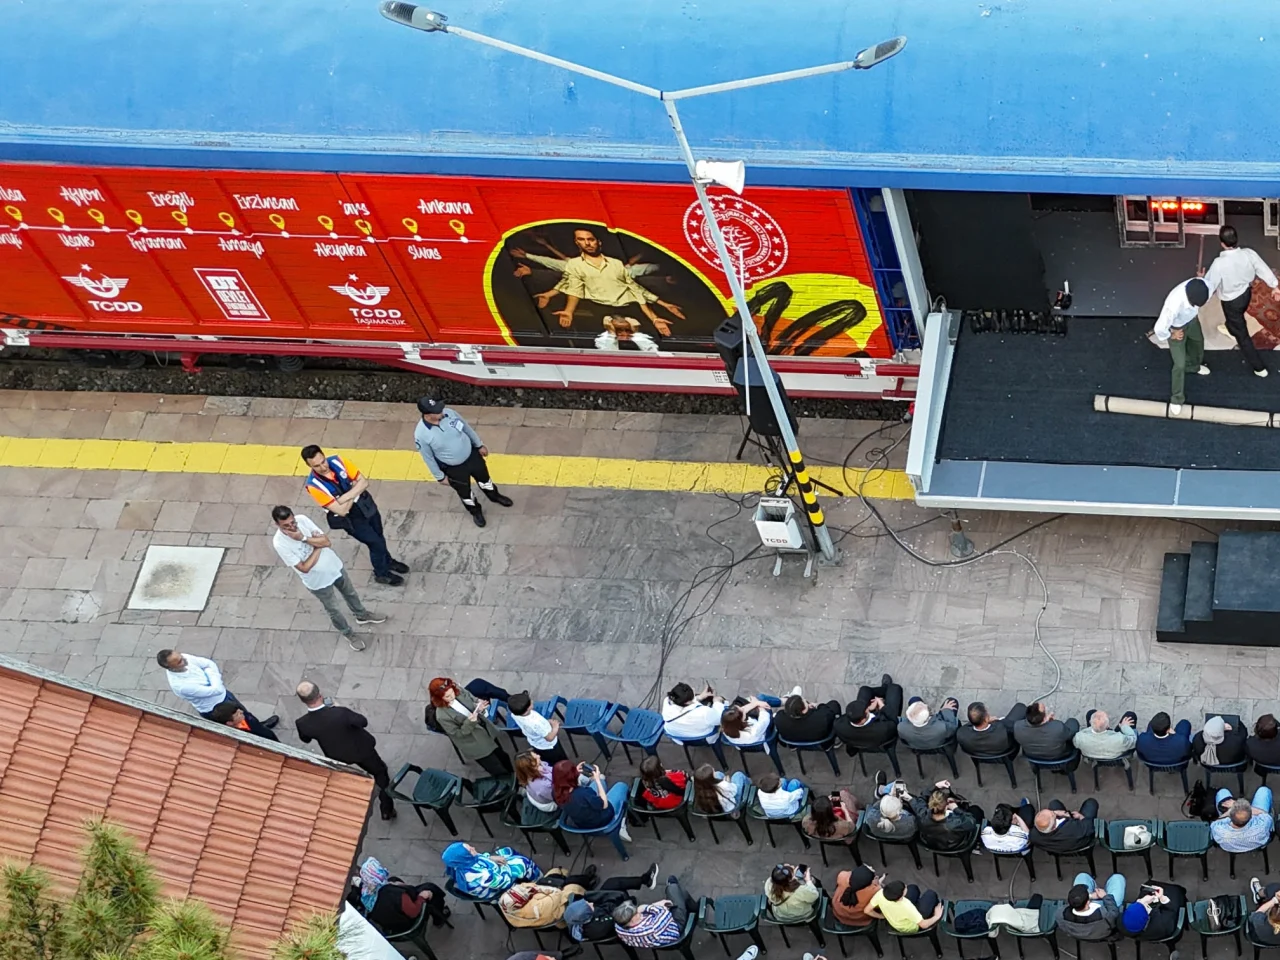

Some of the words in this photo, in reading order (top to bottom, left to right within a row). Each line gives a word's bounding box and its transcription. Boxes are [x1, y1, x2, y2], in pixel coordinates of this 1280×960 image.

[338, 200, 371, 216] ars
[417, 198, 474, 216] Ankara
[313, 242, 368, 261] Akyaka
[215, 290, 251, 303] DEVLET
[88, 300, 143, 312] TCDD
[348, 307, 402, 318] TCDD
